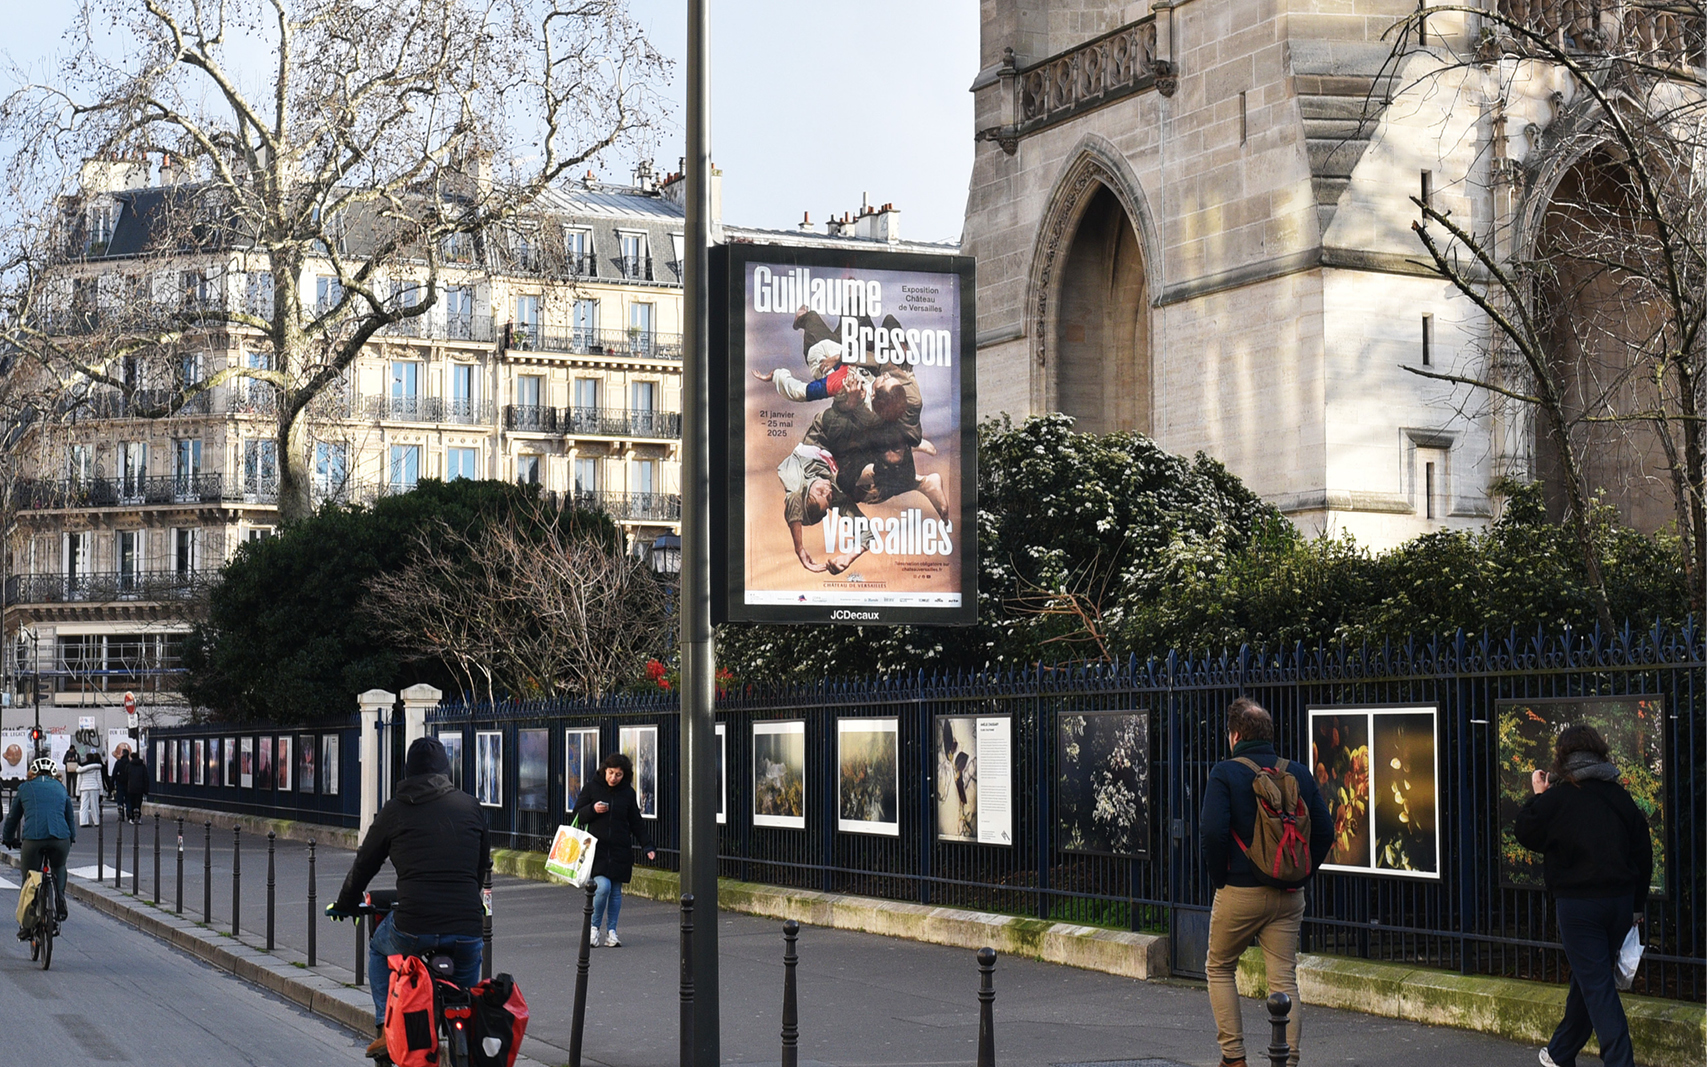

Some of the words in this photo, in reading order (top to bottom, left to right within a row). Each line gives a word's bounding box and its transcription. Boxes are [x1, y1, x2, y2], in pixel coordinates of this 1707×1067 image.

[753, 266, 882, 317] Guillaume
[901, 285, 939, 295] Exposition
[905, 294, 936, 304] Château
[908, 304, 943, 313] Versailles
[841, 316, 952, 367] Bresson
[759, 410, 768, 418] 21
[769, 410, 795, 419] janvier
[767, 420, 778, 428] 25
[779, 420, 794, 428] mai
[766, 429, 788, 437] 2025
[822, 506, 953, 556] Versailles
[830, 609, 880, 620] JCDecaux
